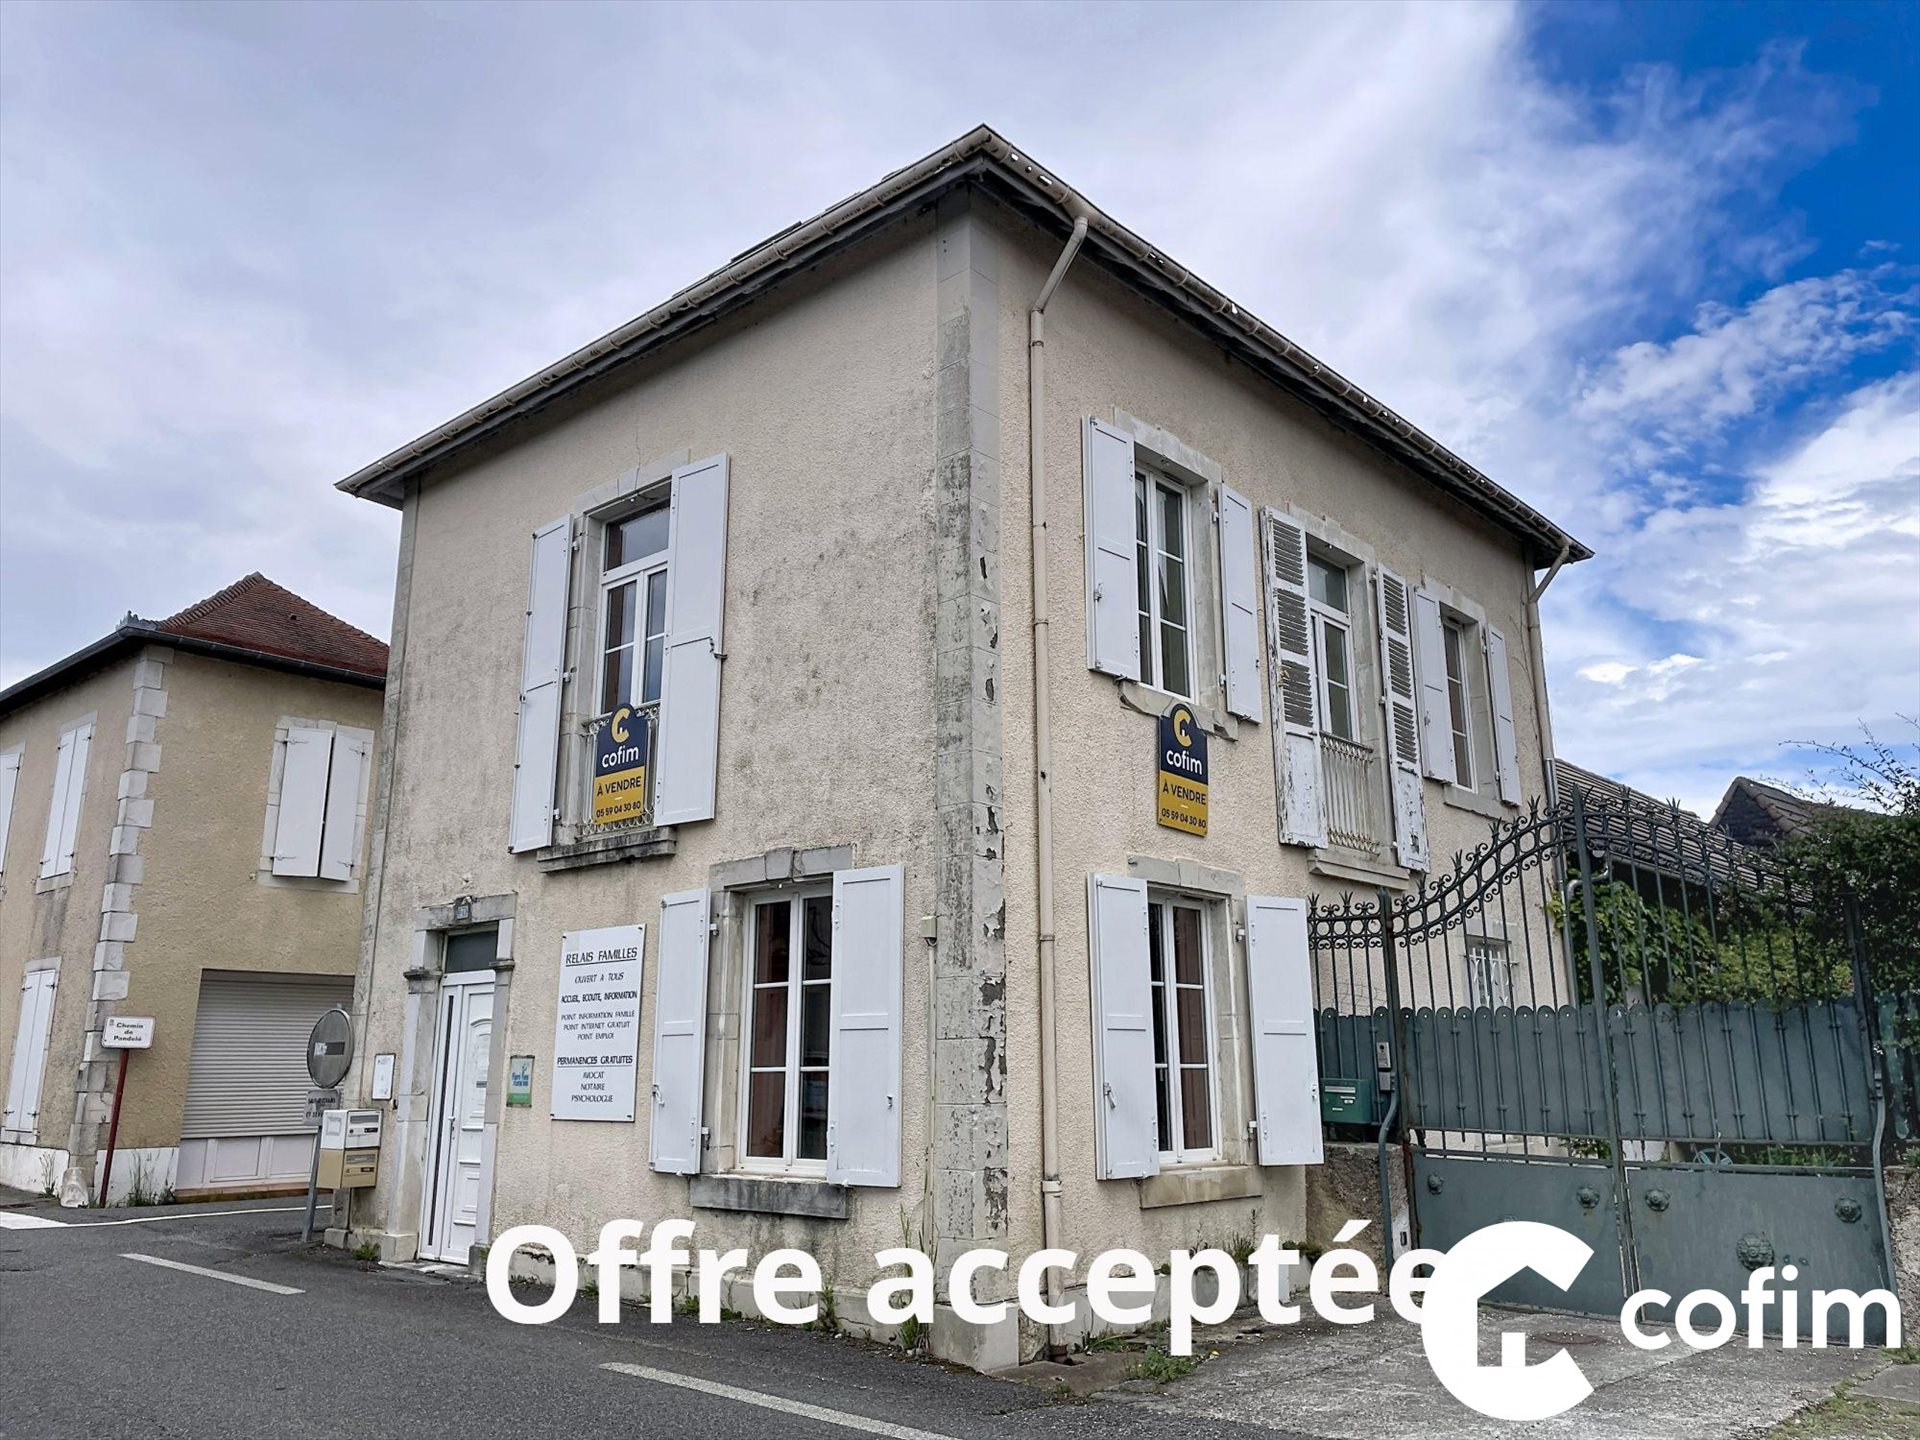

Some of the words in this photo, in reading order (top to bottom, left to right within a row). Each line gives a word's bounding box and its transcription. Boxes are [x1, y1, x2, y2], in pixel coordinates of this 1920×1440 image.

[602, 745, 639, 768] cofim
[1166, 750, 1203, 775] cofim
[605, 776, 641, 793] VENDRE
[1171, 784, 1206, 805] VENDRE
[596, 809, 604, 817] 05
[606, 807, 613, 816] 59
[614, 805, 622, 814] 04
[1162, 808, 1170, 817] 05
[1171, 811, 1179, 820] 59
[1180, 813, 1188, 823] 04
[565, 951, 594, 964] RELAIS
[598, 947, 638, 960] FAMILLES
[574, 974, 597, 983] OUVERT
[608, 972, 624, 981] TOUS
[604, 990, 638, 1000] INFORMATION
[561, 1013, 576, 1021] POINT
[578, 1011, 613, 1020] INFORMATION
[615, 1010, 635, 1018] FAMILLE
[581, 1022, 605, 1030] INTERNET
[557, 1056, 598, 1065] PERMANENCES
[600, 1055, 633, 1064] GRATUITES
[583, 1071, 604, 1079] AVOCAT
[580, 1083, 605, 1091] NOTAIRE
